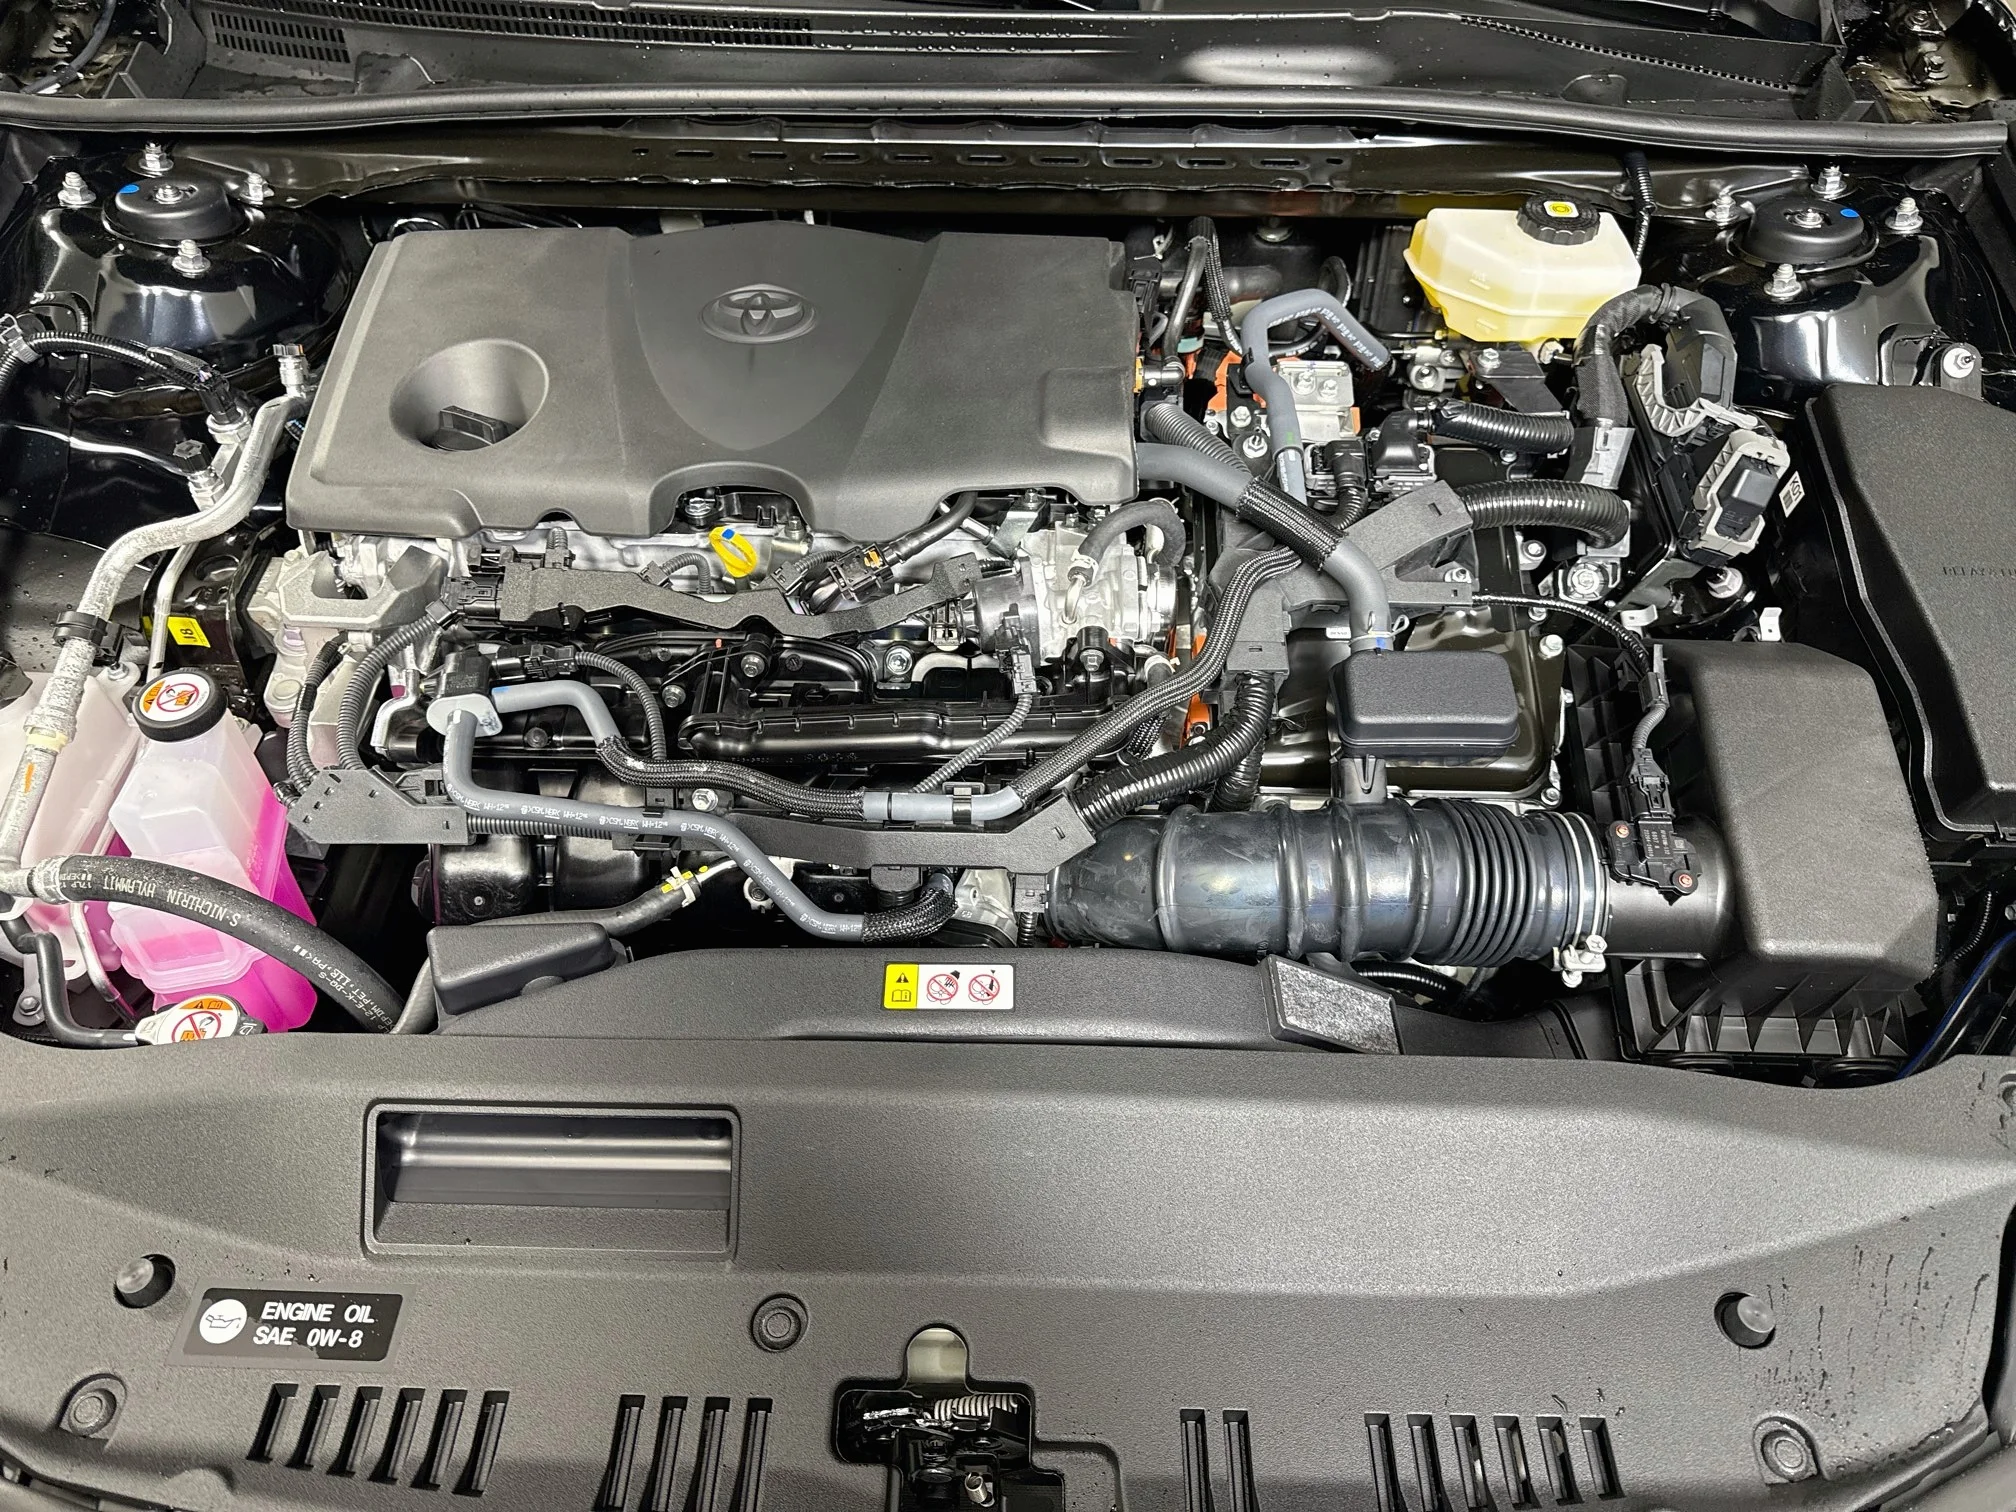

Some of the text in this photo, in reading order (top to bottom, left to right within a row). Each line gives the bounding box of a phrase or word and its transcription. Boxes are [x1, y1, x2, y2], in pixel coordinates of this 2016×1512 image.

[103, 875, 157, 898] HYLAMMIT
[261, 1301, 375, 1324] ENGINE OIL
[252, 1325, 364, 1349] SAE 0W-8
